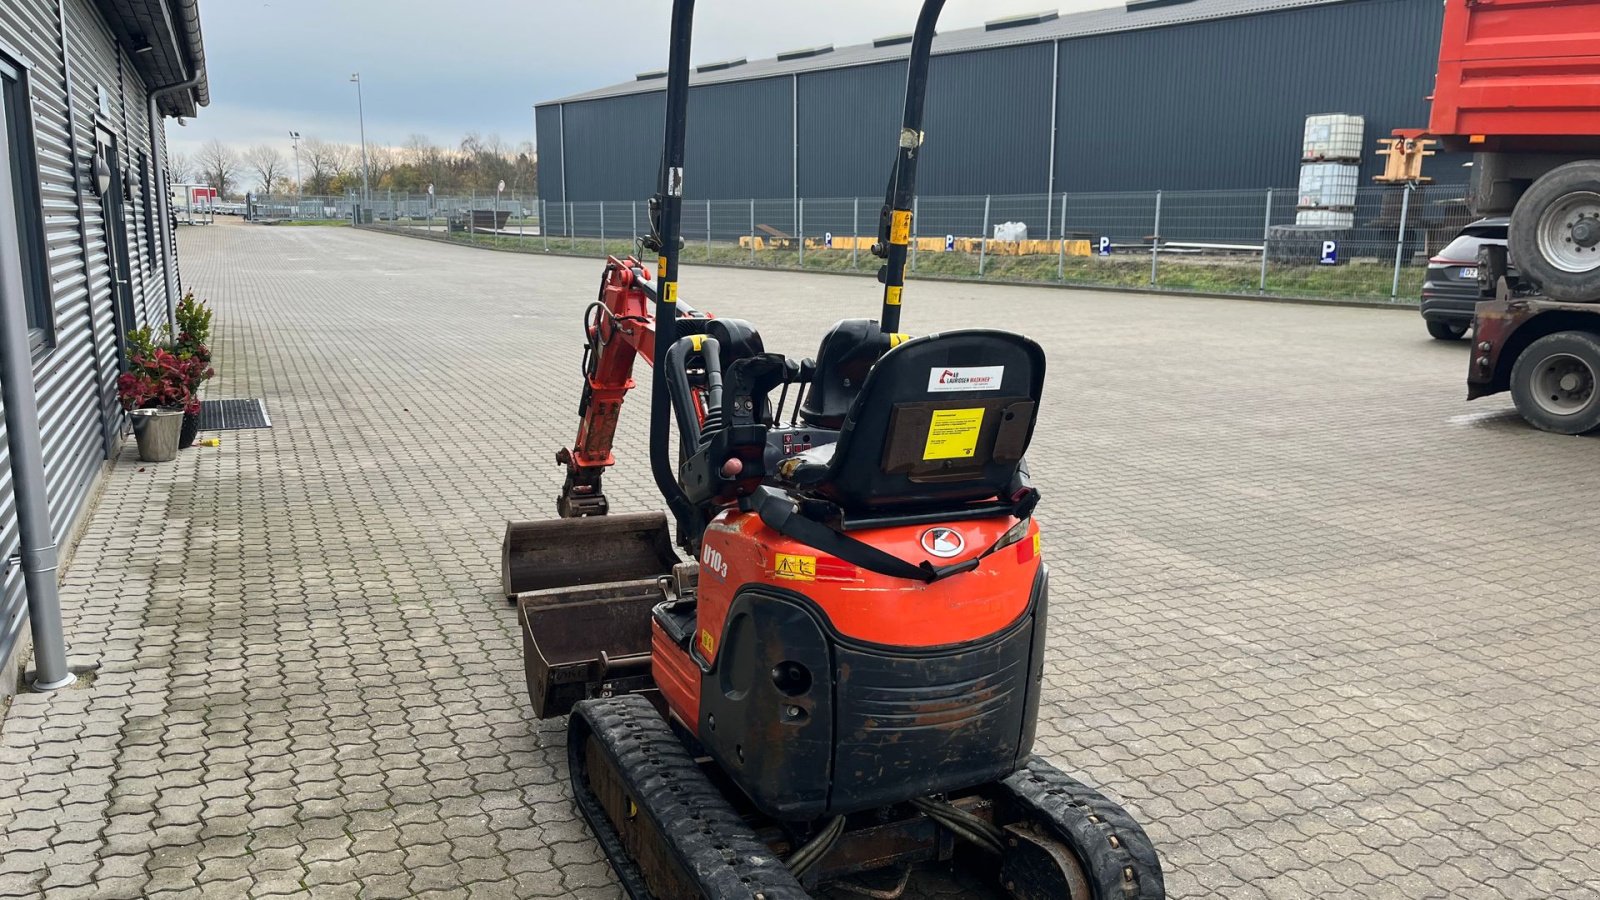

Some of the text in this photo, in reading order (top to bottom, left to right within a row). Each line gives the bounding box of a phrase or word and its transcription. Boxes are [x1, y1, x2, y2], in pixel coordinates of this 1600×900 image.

[825, 232, 832, 244] P
[946, 235, 954, 247] P
[1100, 236, 1110, 252] P
[1322, 240, 1336, 258] P
